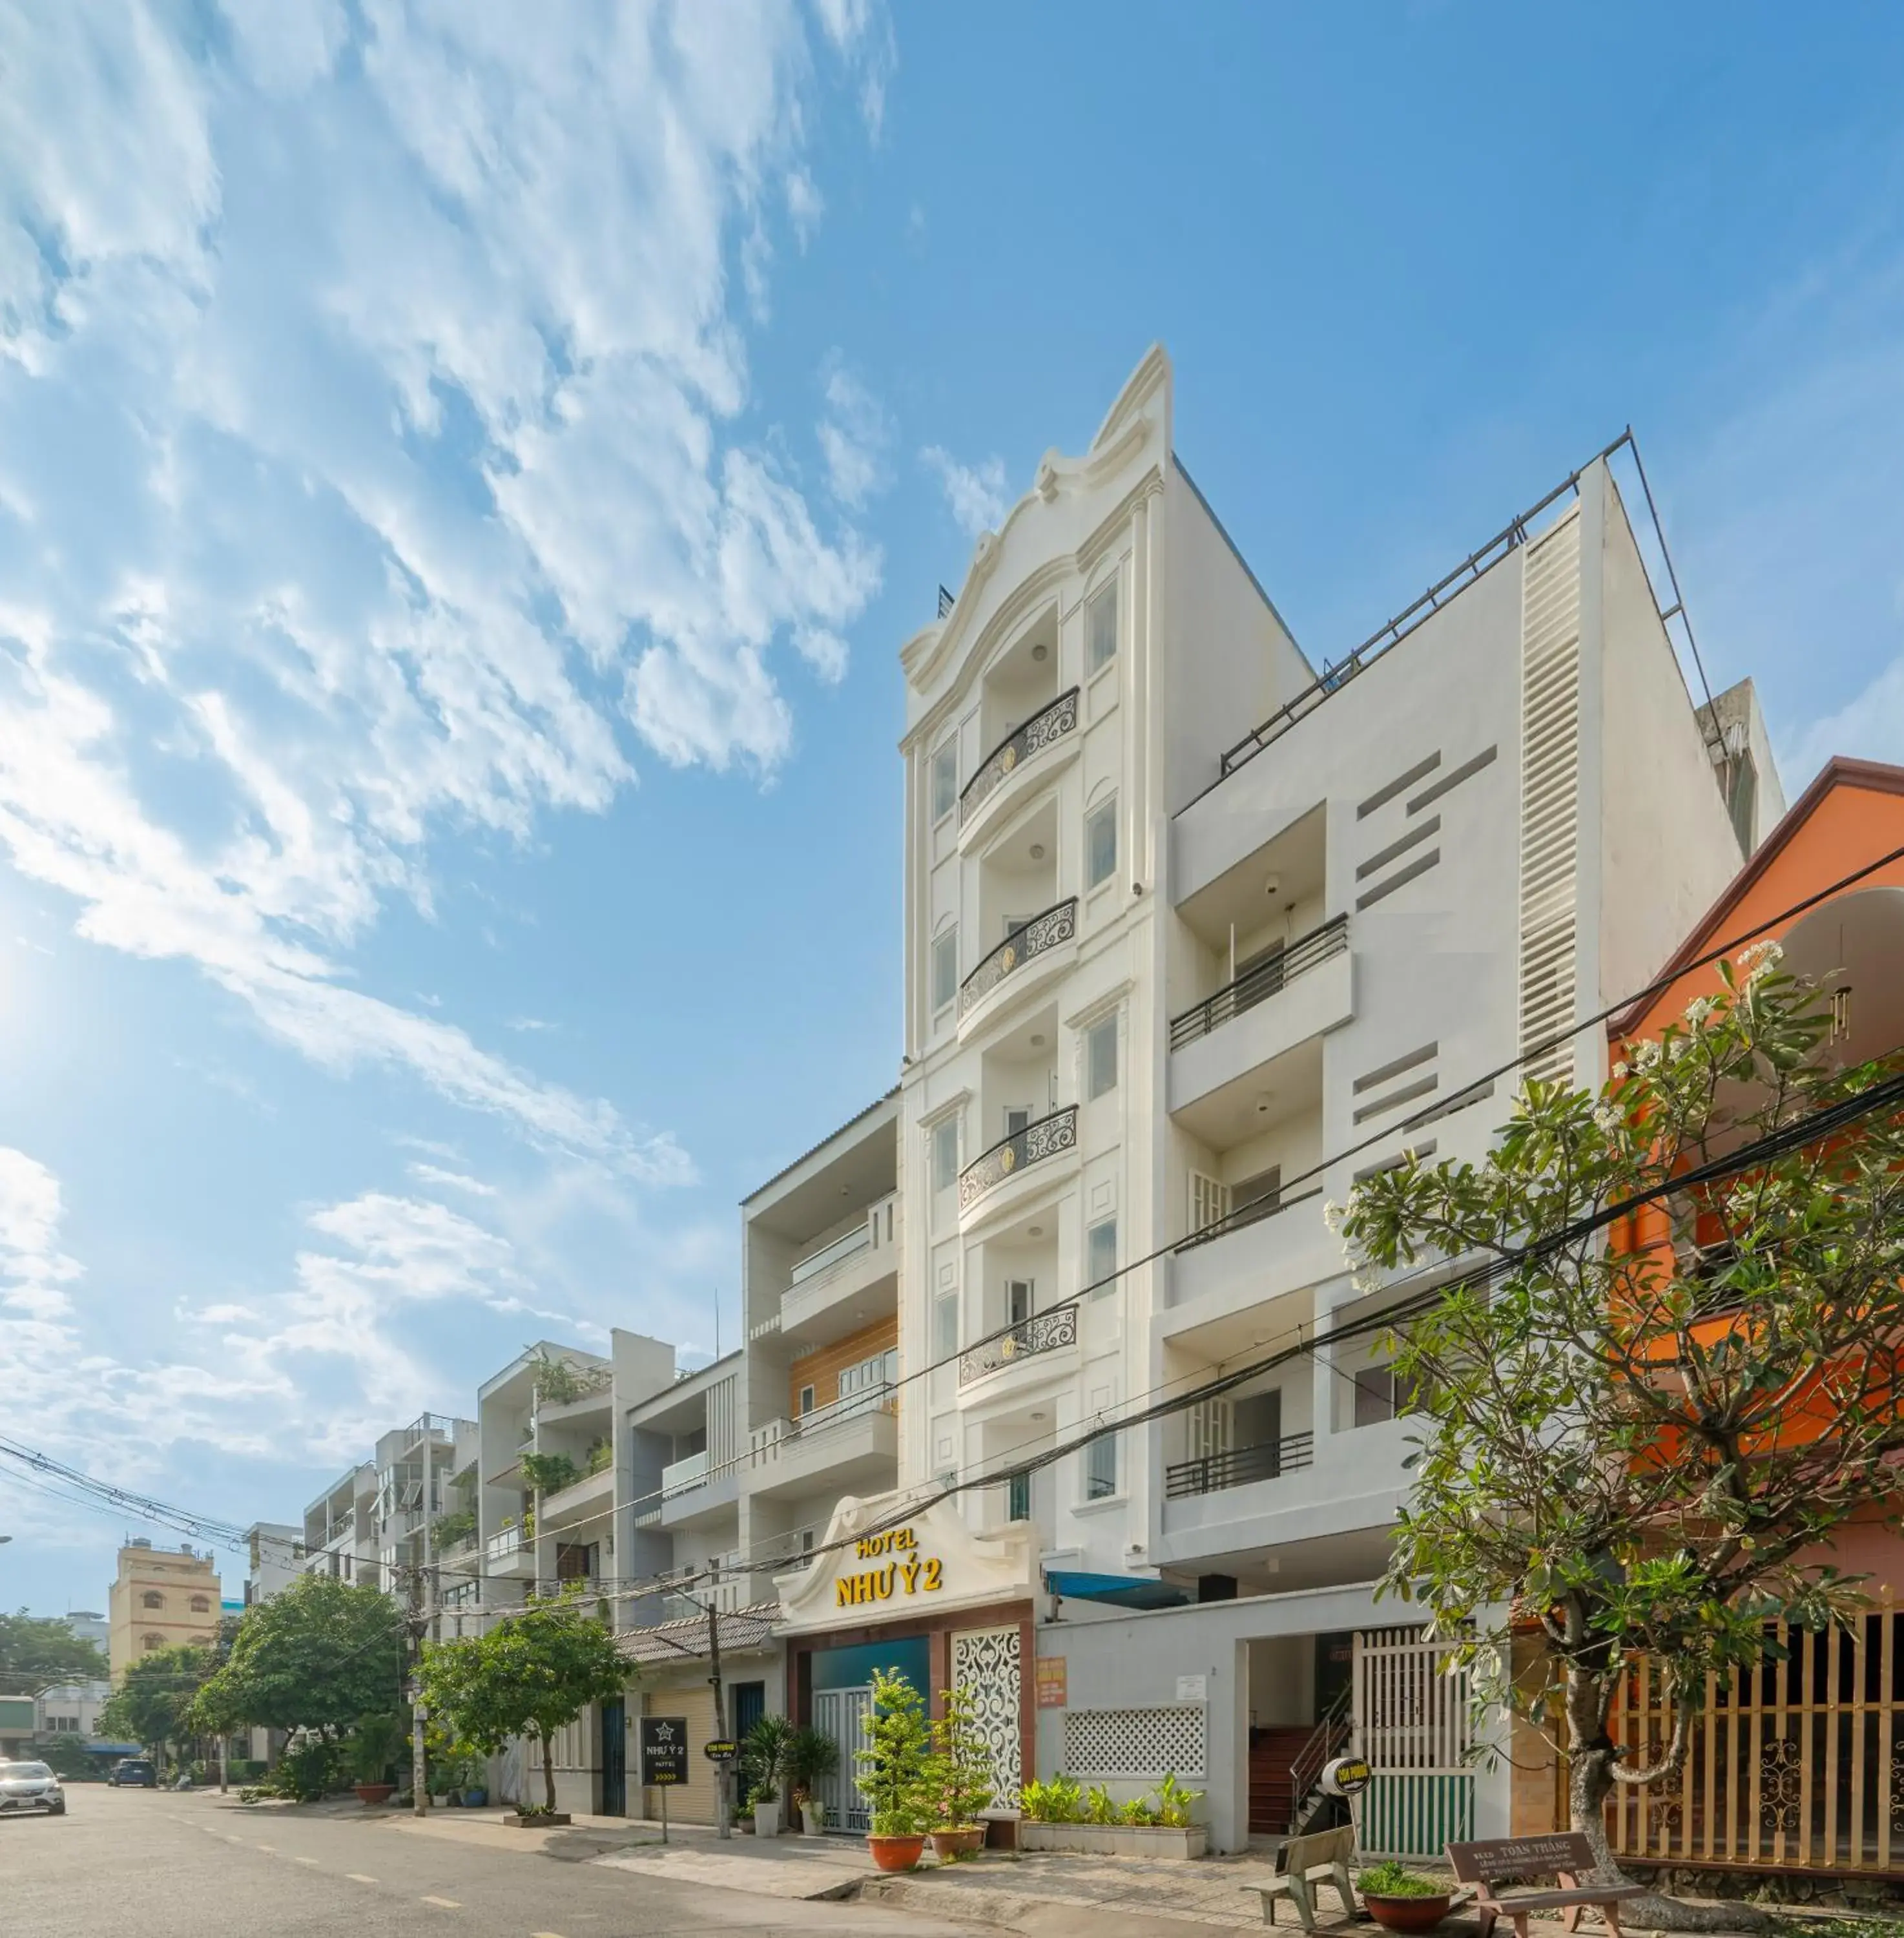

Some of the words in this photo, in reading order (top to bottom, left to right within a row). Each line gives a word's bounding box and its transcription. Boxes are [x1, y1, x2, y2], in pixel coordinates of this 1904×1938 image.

[856, 1528, 919, 1559] HOTEL
[836, 1561, 896, 1607] NHƯ
[898, 1550, 921, 1594] Ý
[923, 1558, 943, 1591] 2
[678, 1746, 684, 1755] 2
